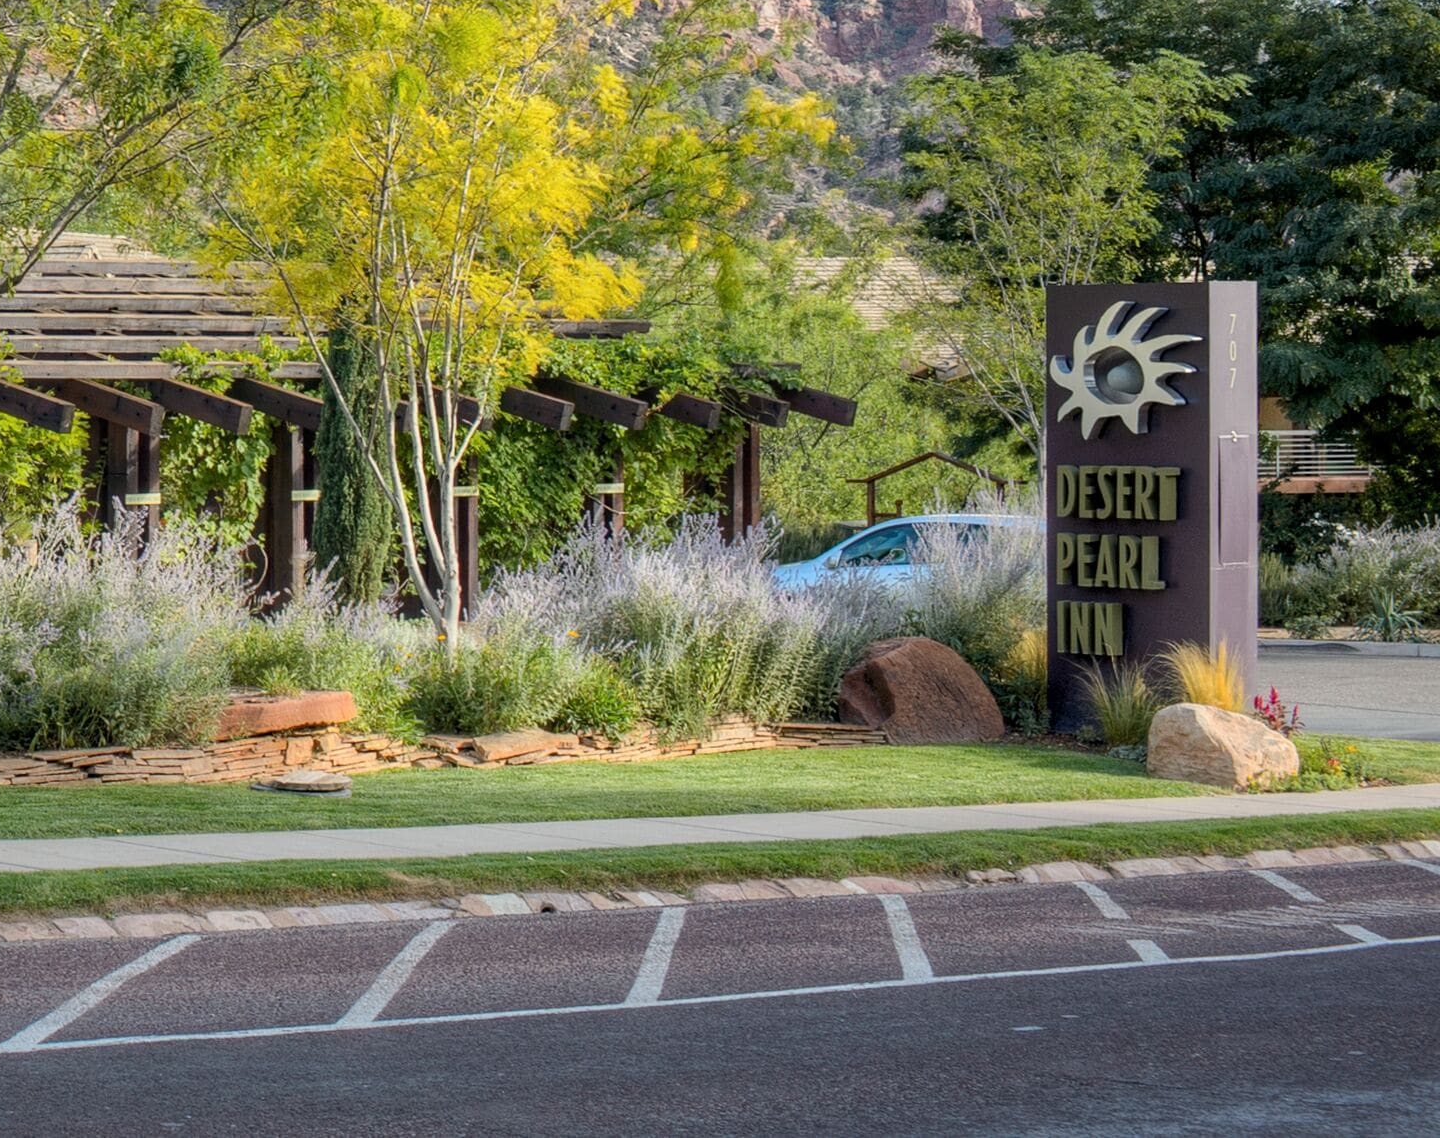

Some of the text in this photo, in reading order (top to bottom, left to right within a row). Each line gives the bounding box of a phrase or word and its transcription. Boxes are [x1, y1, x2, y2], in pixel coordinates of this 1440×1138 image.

[1229, 313, 1237, 389] 707
[1056, 465, 1181, 521] DESERT
[1056, 533, 1166, 590] PEARL
[1056, 600, 1123, 656] INN
